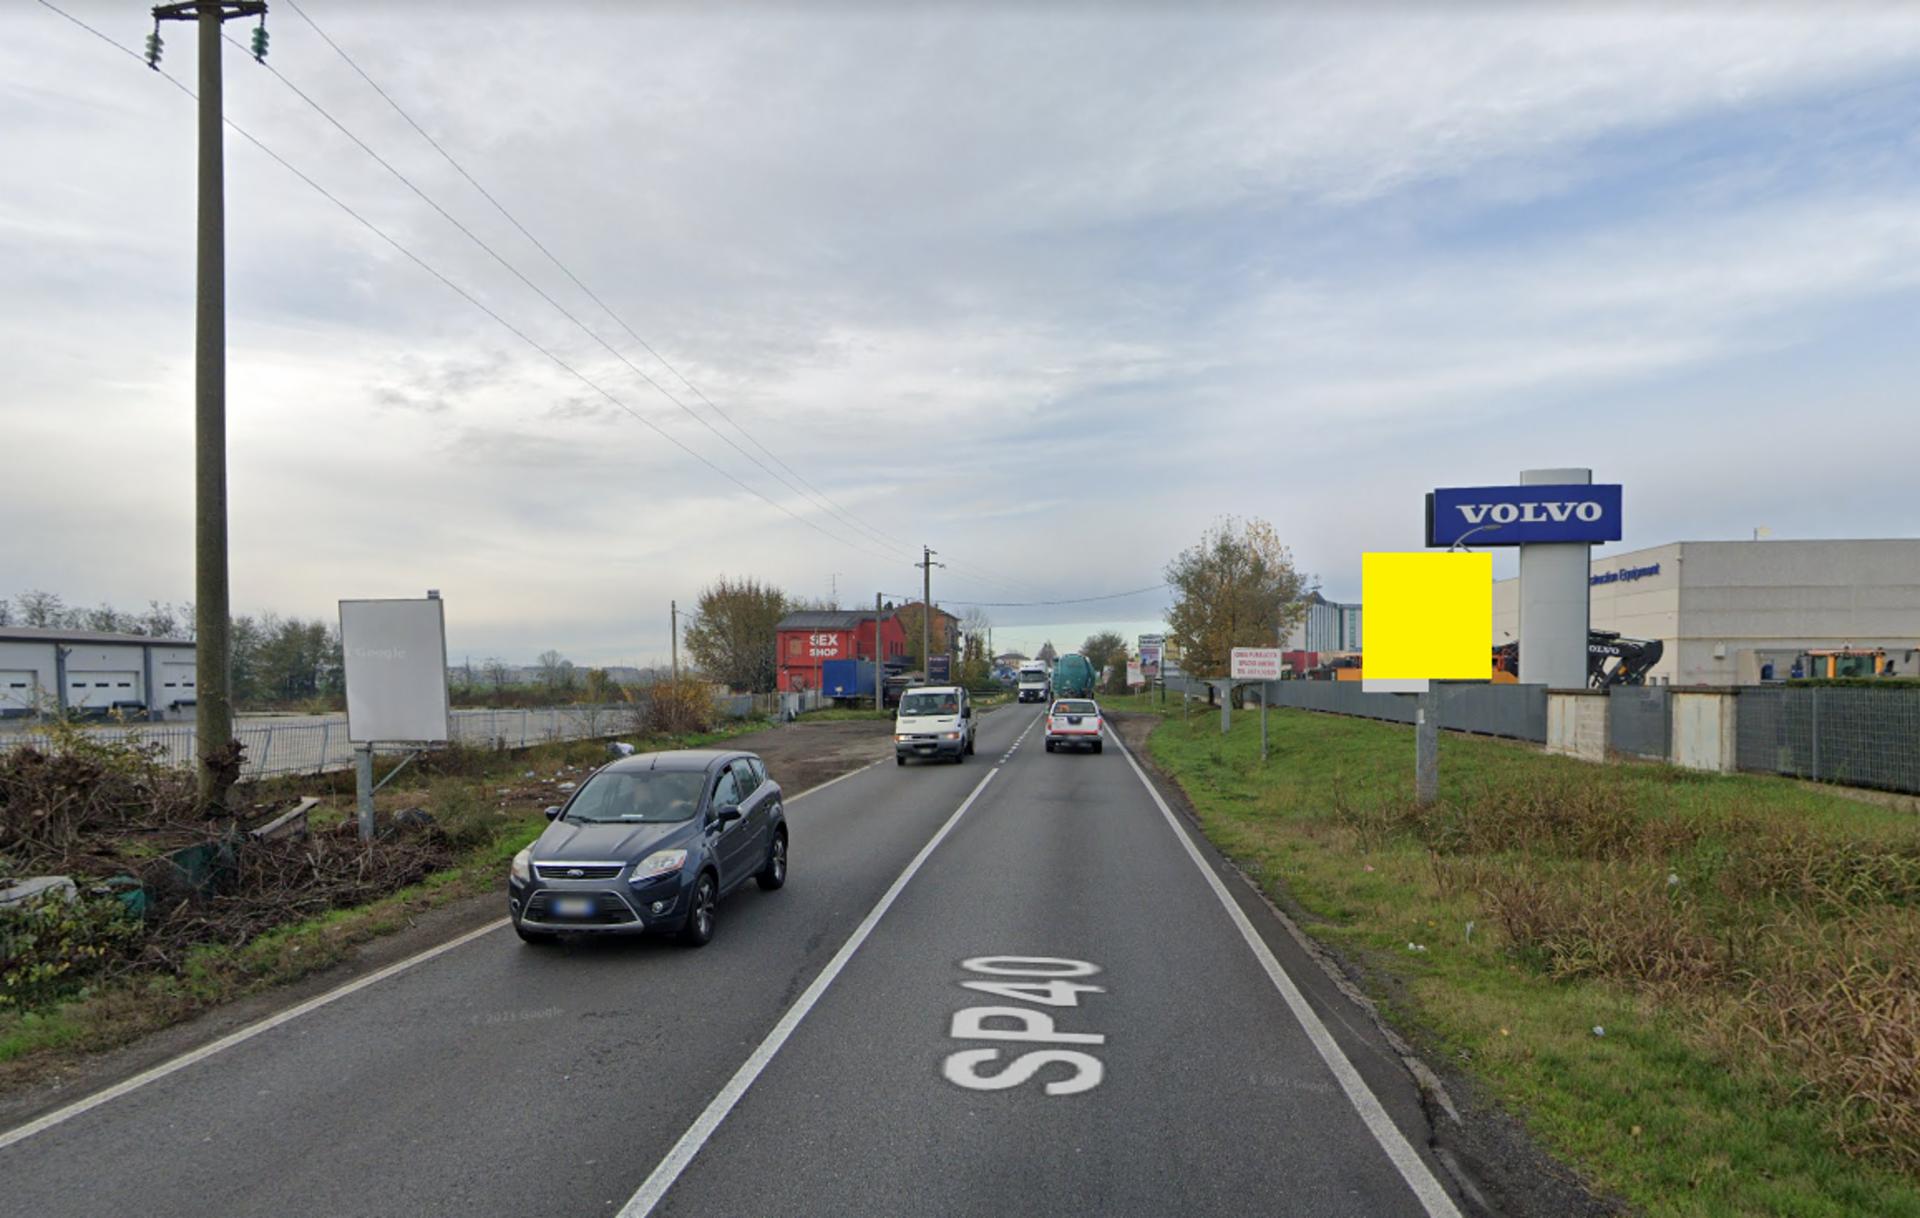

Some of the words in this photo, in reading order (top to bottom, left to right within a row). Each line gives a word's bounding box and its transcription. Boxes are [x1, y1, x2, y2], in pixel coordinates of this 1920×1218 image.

[1456, 501, 1602, 524] VOLVO
[809, 633, 839, 646] SEX
[809, 648, 839, 657] SHOP
[1588, 644, 1620, 654] OLVO
